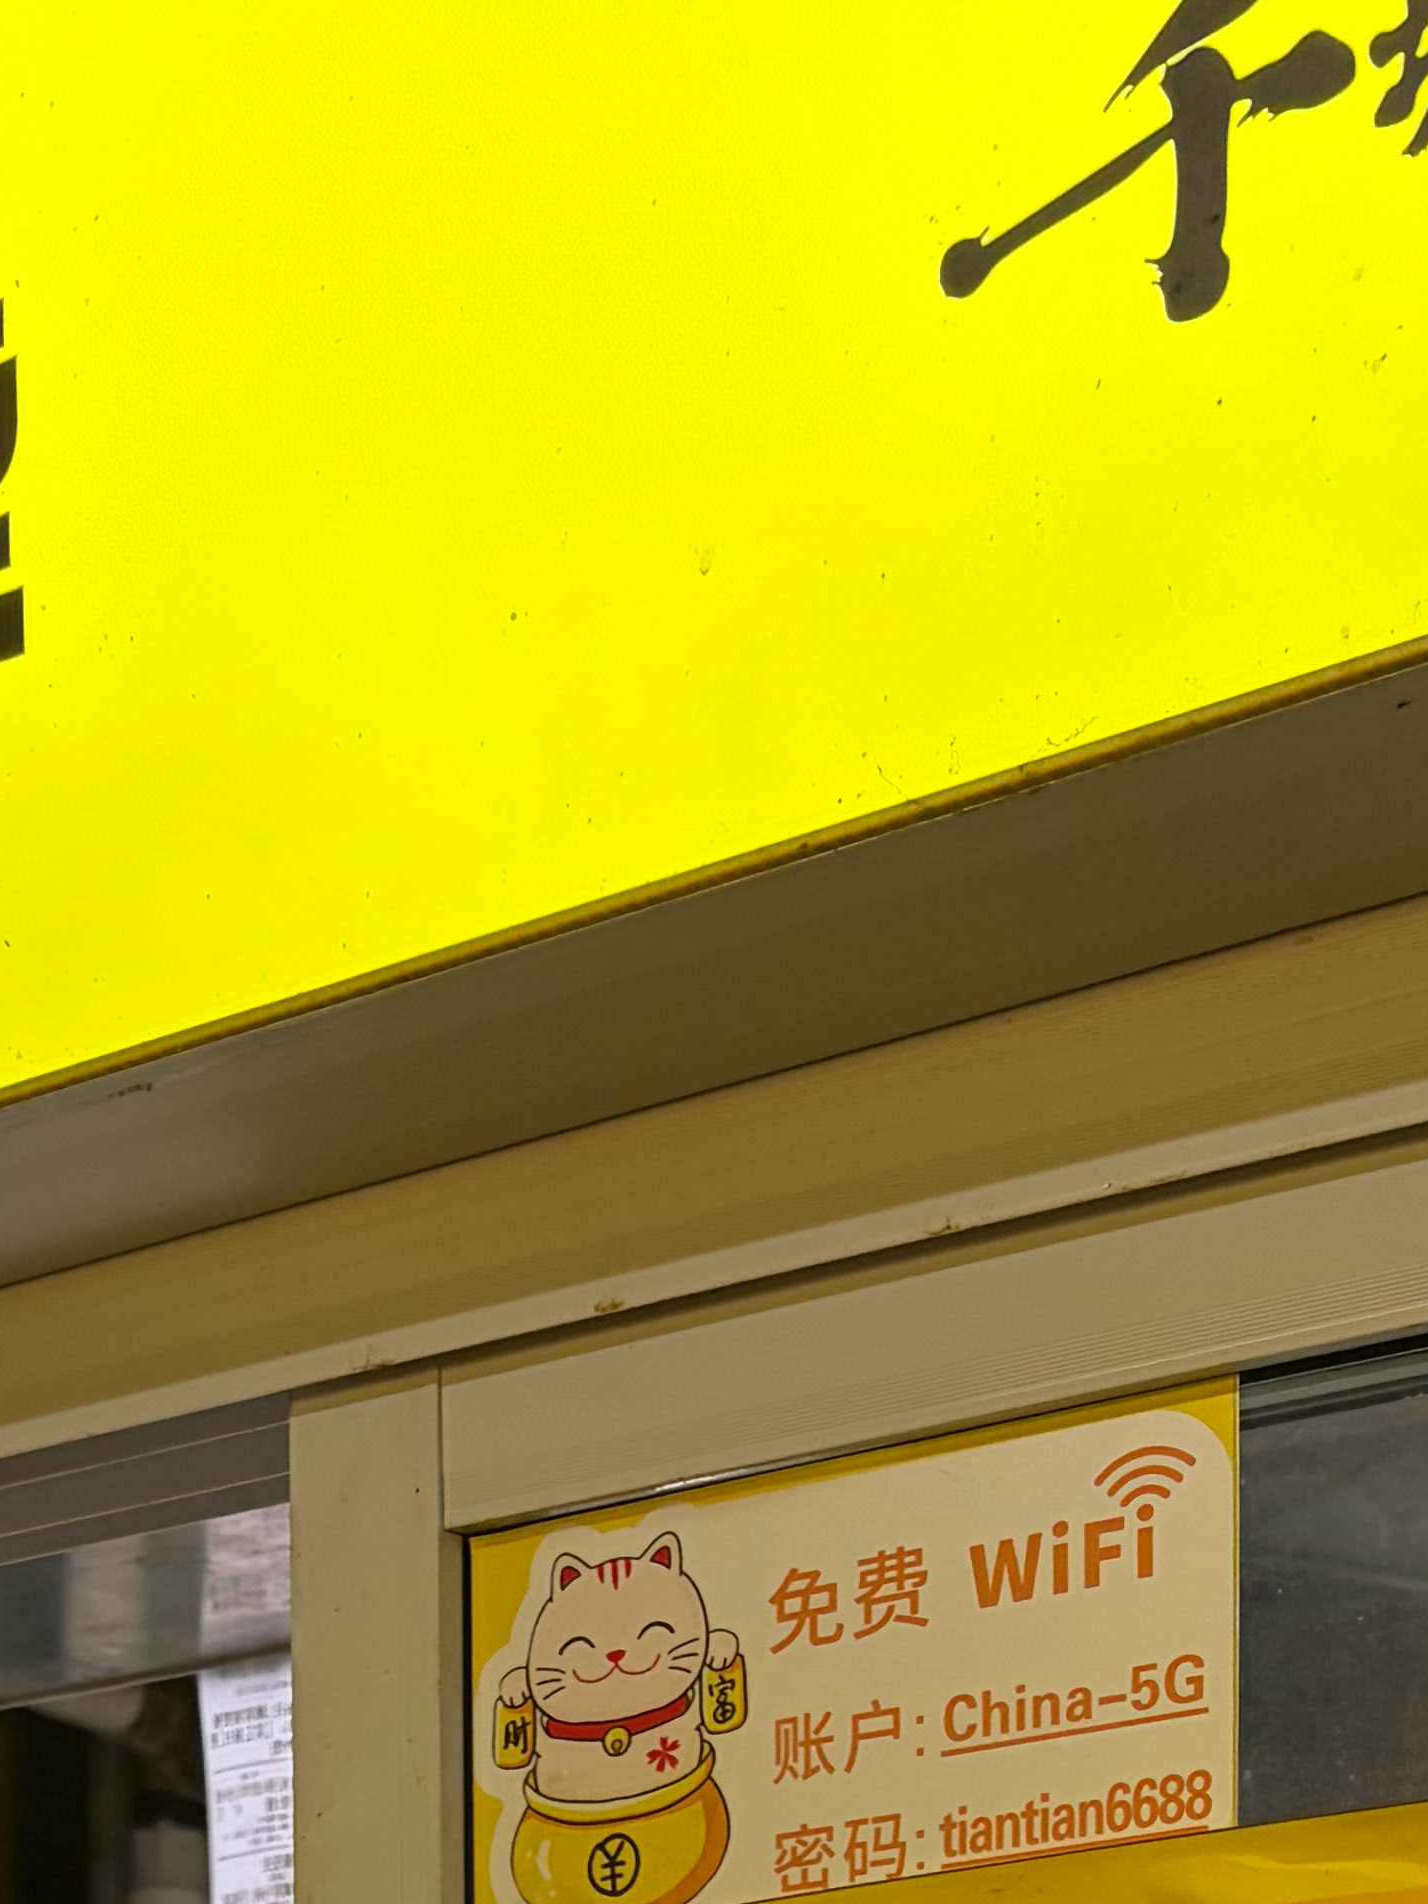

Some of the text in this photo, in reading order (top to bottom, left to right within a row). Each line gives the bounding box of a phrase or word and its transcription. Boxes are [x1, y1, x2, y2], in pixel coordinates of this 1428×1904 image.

[768, 1503, 1155, 1656] 免费 WiFi
[940, 1767, 1214, 1859] tiantian6688
